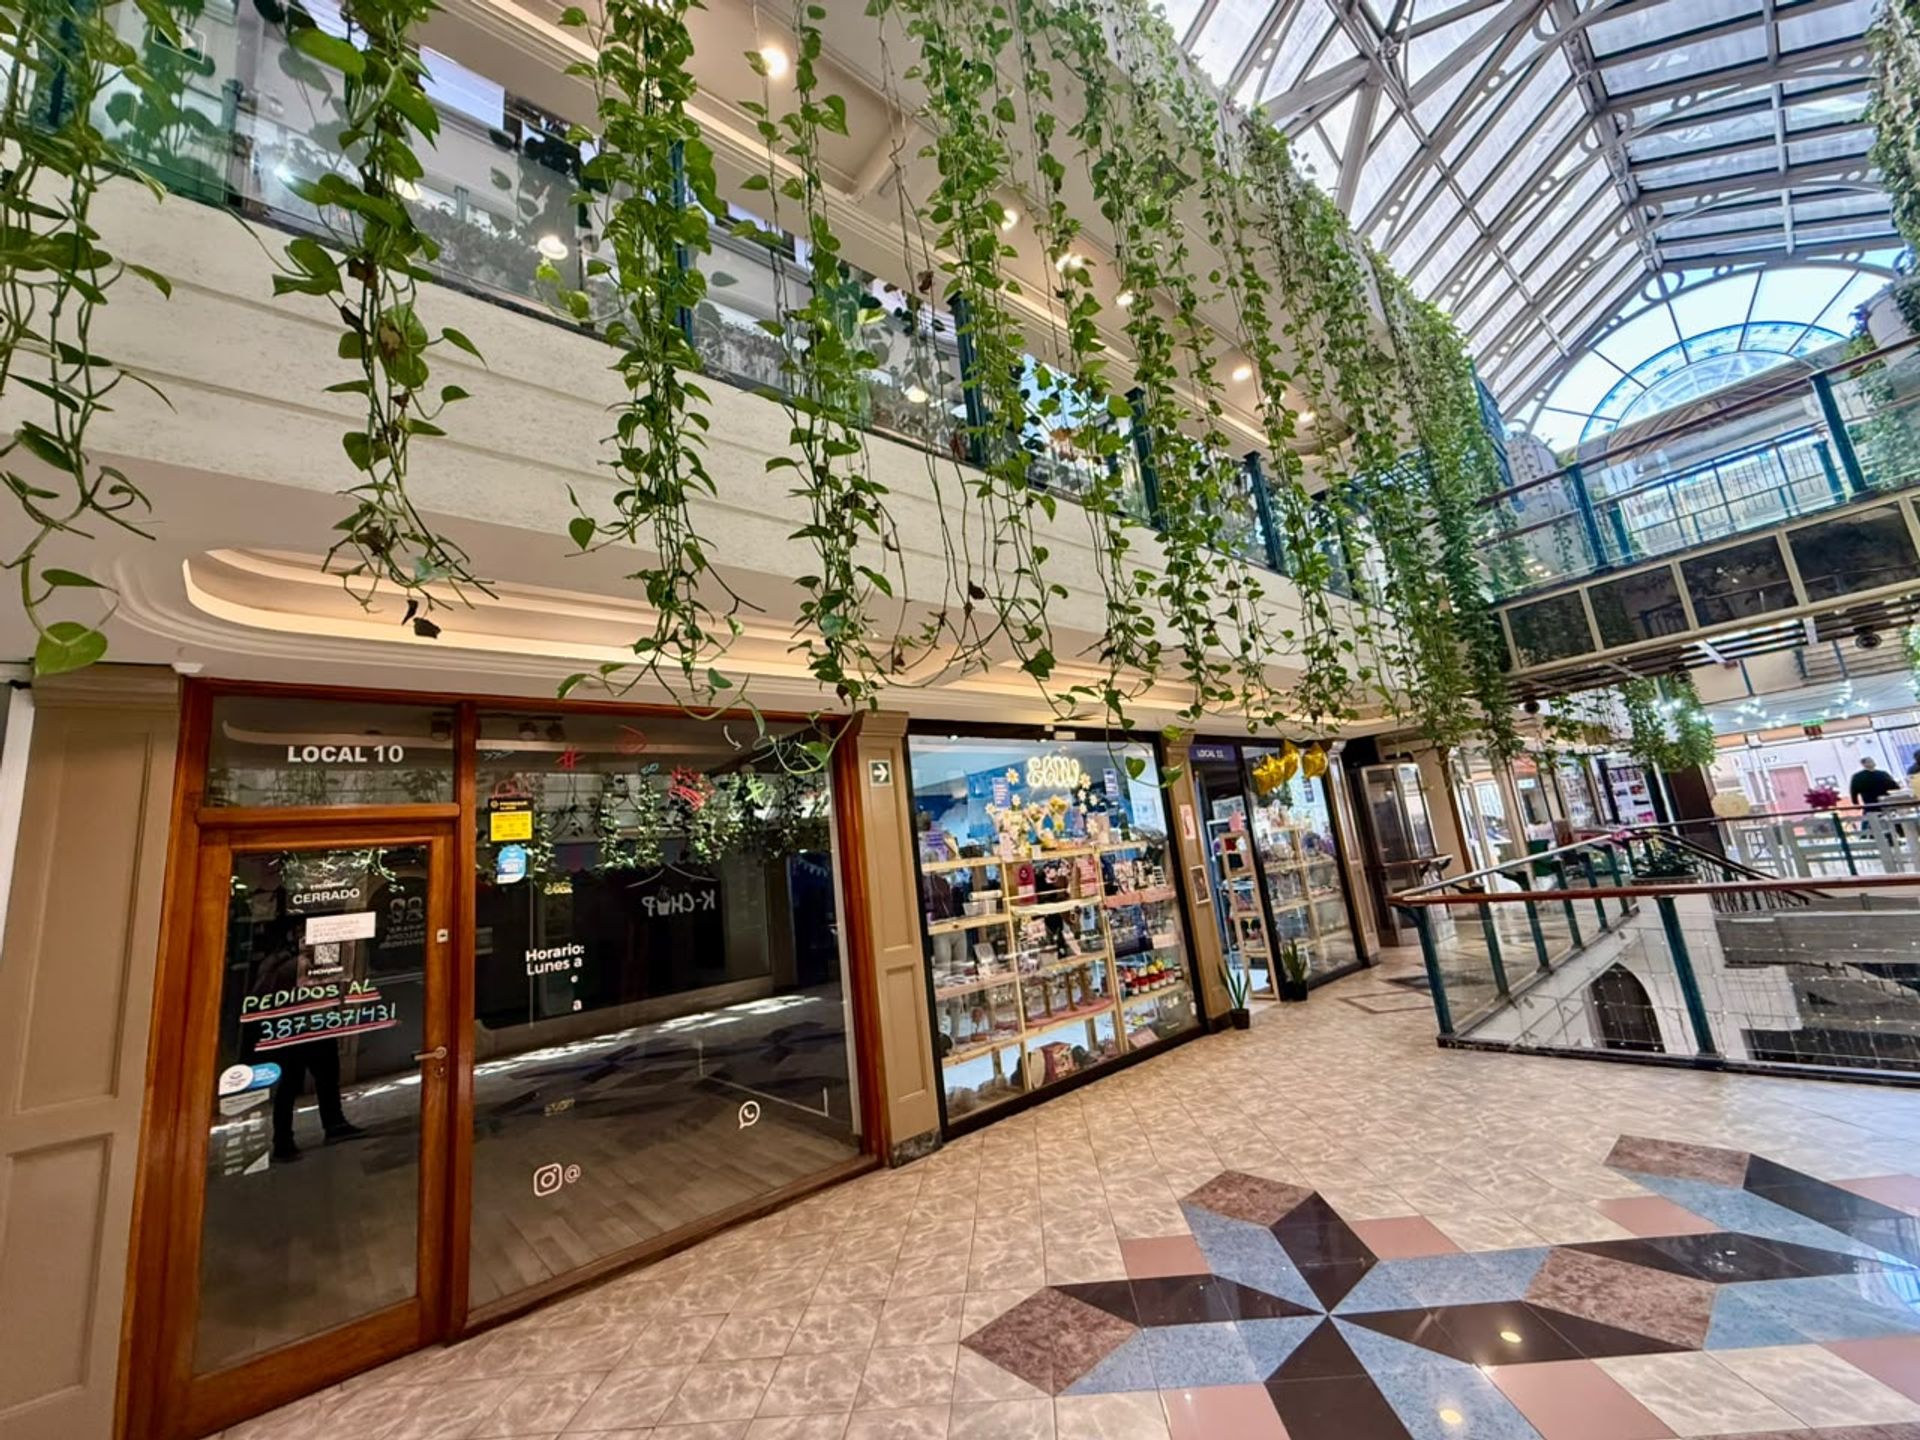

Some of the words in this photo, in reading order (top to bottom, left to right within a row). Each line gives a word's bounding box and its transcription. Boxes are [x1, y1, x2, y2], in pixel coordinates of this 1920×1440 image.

[287, 745, 367, 763] LOCAL
[373, 744, 404, 763] 10
[292, 887, 360, 905] CERRADO
[525, 942, 585, 962] Horario:
[526, 959, 570, 976] Lunes
[573, 957, 582, 968] a
[241, 982, 340, 1014] PEDIDOS
[348, 978, 377, 995] AL
[572, 999, 582, 1011] a
[259, 1002, 397, 1041] 3875871431
